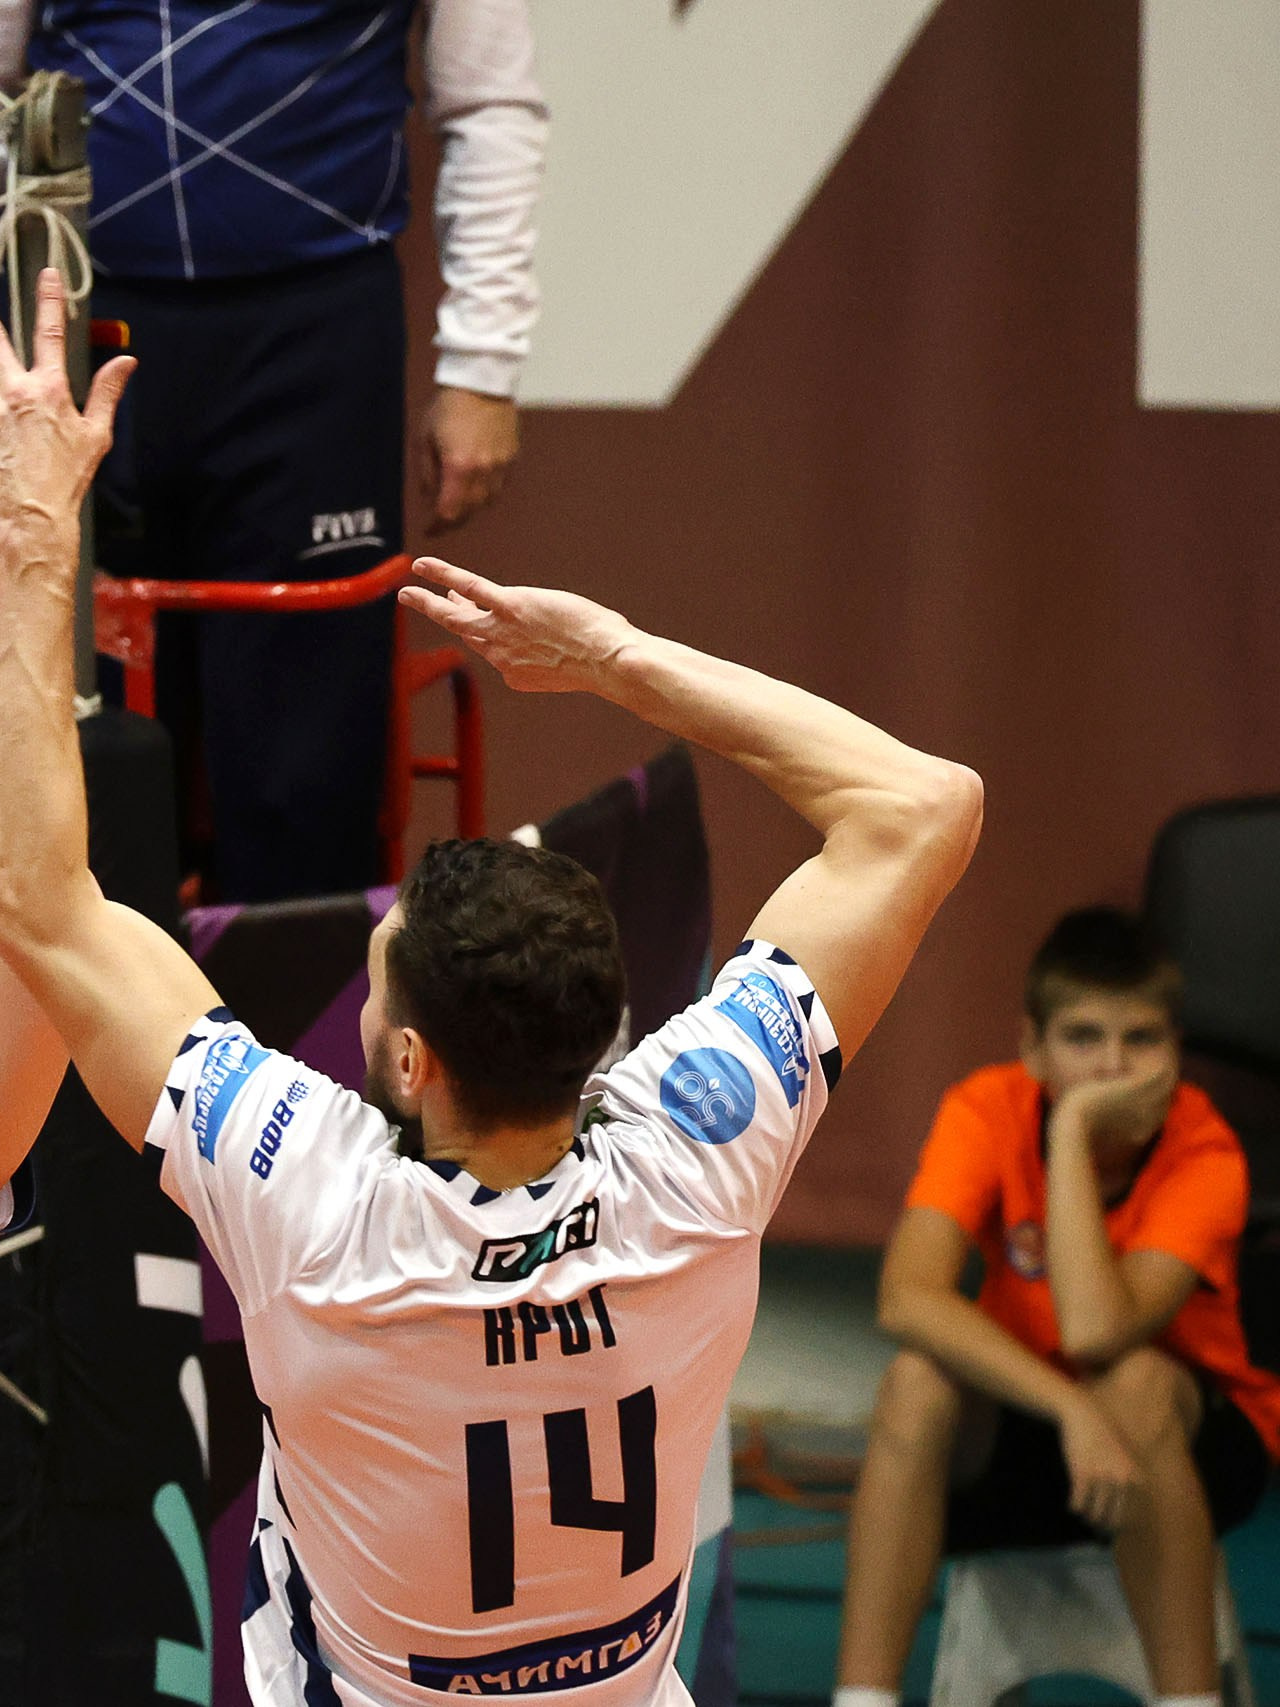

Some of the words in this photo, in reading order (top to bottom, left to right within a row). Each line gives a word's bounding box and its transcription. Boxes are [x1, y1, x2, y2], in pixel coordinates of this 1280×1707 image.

[249, 1099, 295, 1181] ВФВ
[464, 1385, 658, 1614] 14
[447, 1610, 662, 1695] АЧИМГАЗ
